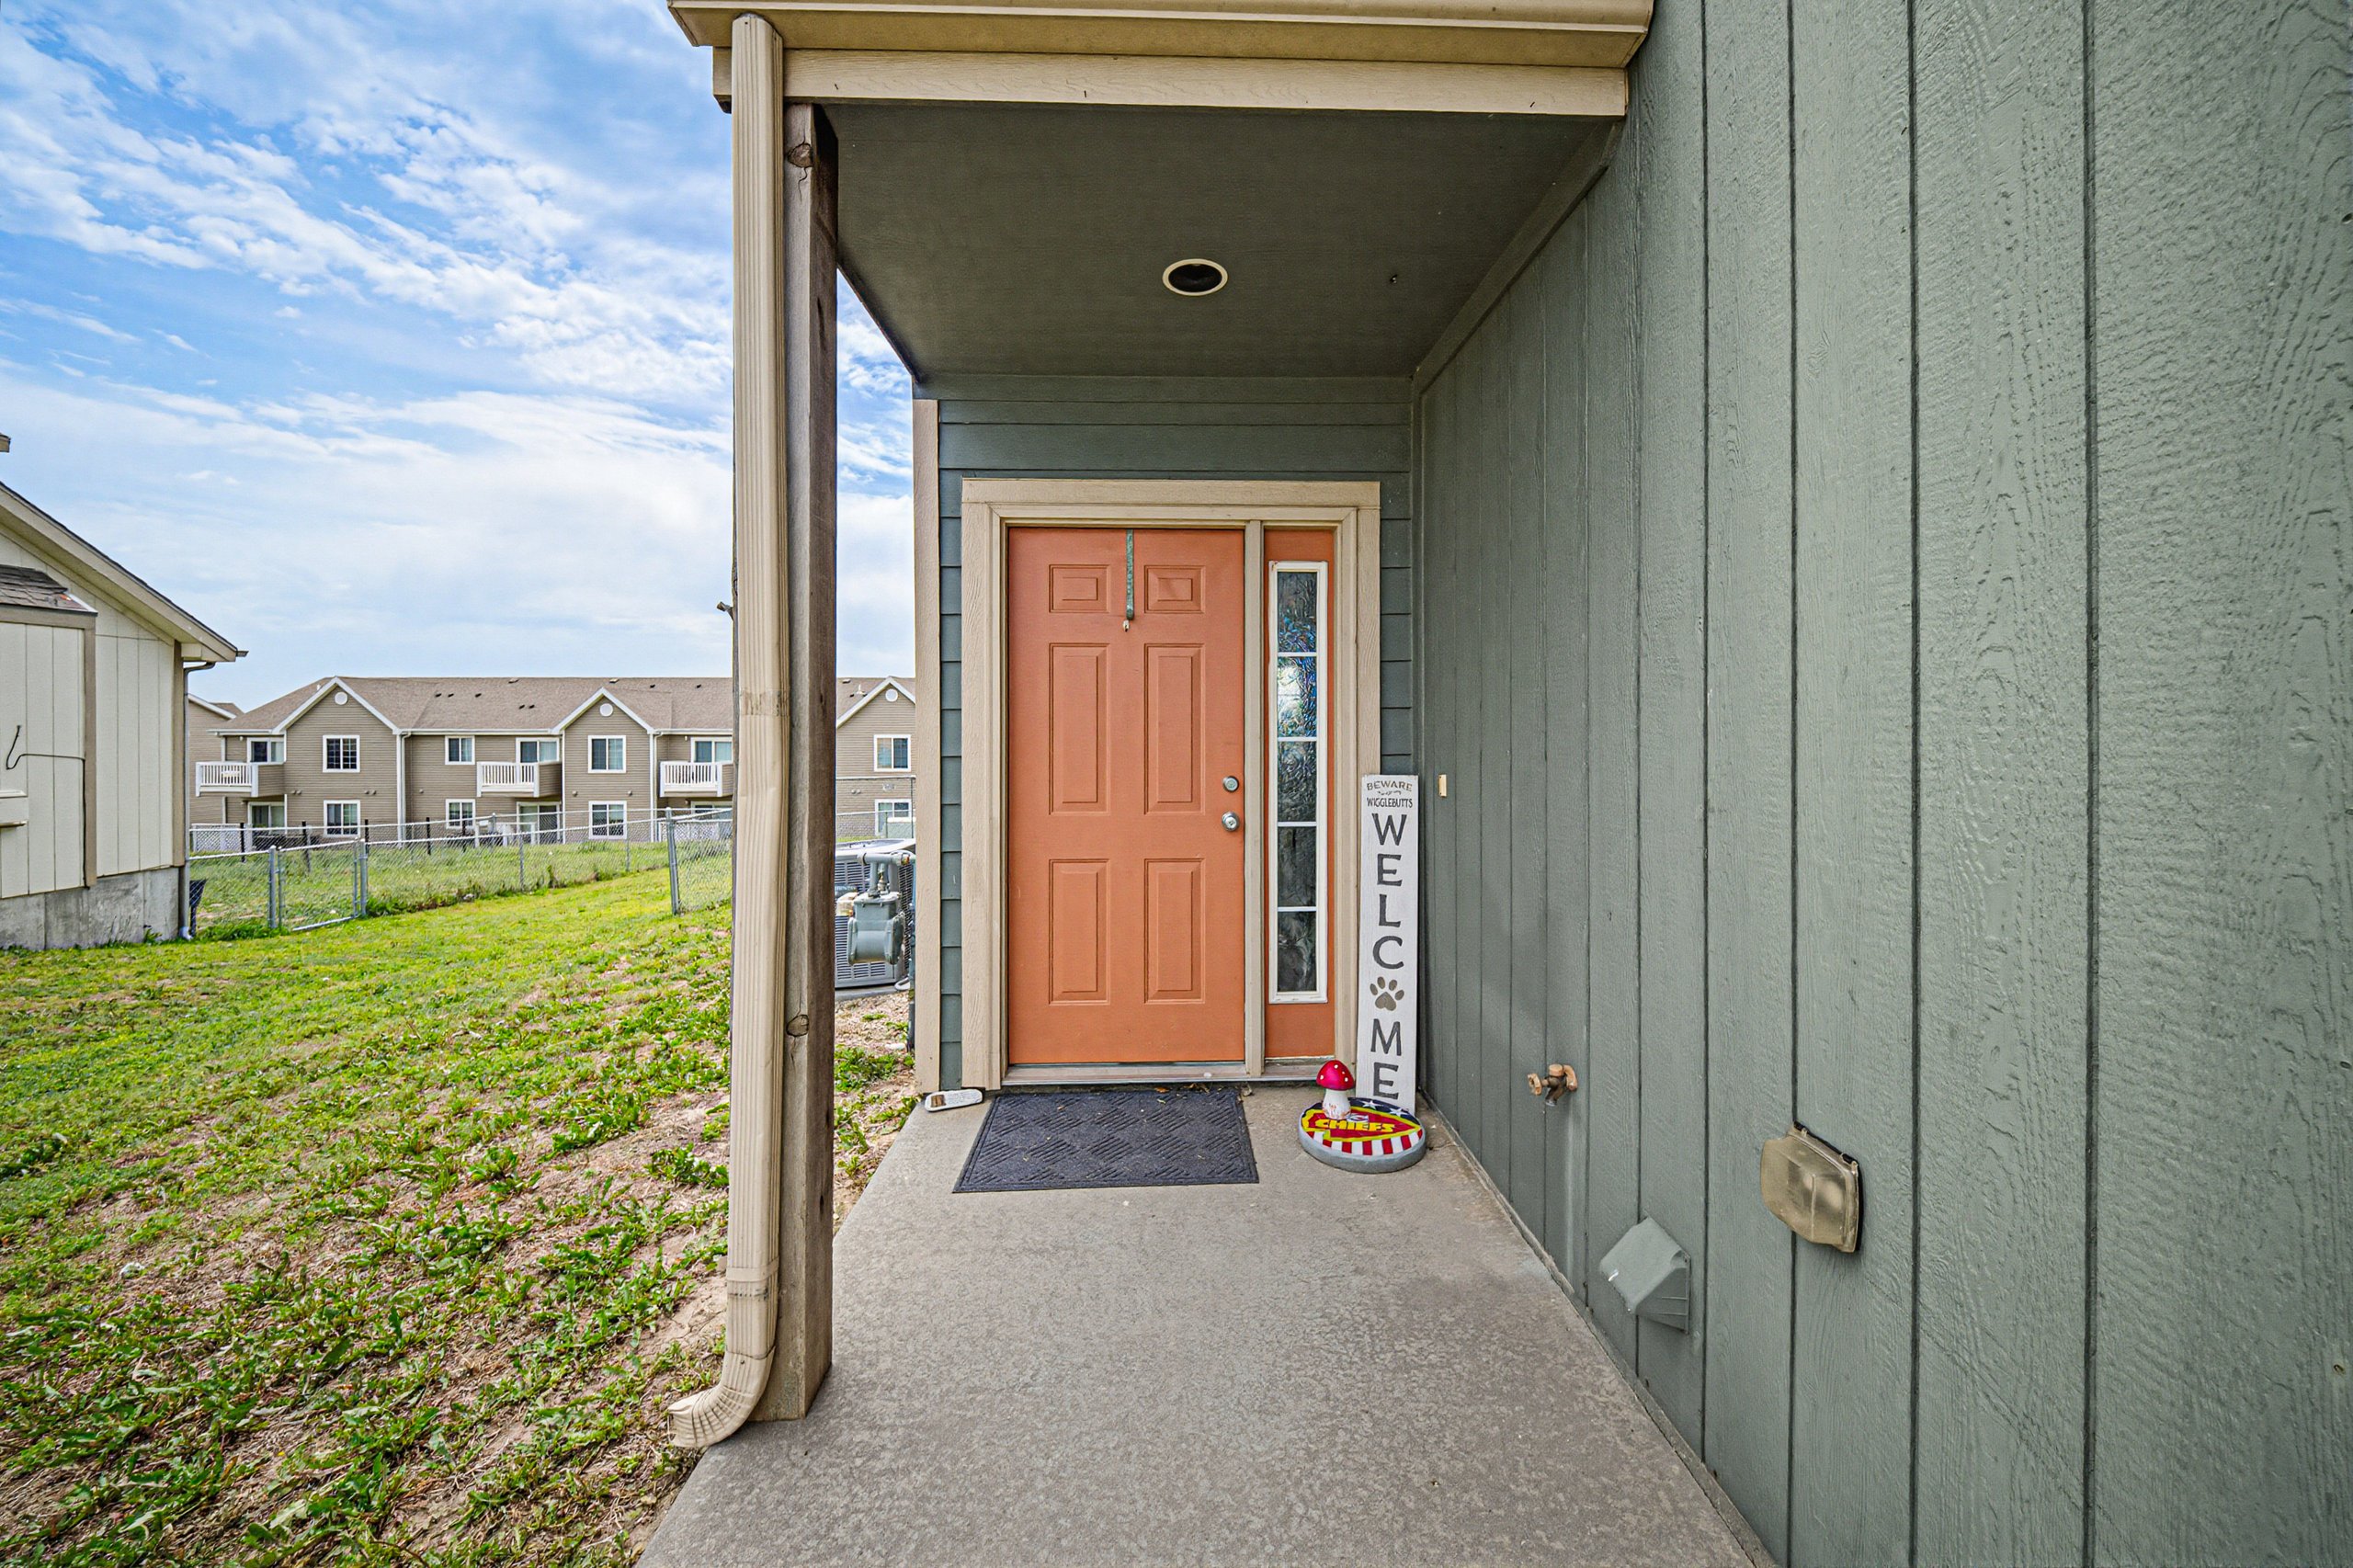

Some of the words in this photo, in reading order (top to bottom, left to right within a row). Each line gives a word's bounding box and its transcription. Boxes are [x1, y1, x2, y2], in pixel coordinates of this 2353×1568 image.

[1366, 780, 1413, 791] BEWARE
[1366, 797, 1414, 809] WIGGLEBUTTS
[1370, 812, 1407, 1099] WELCME
[1315, 1119, 1395, 1132] CHIEFS
